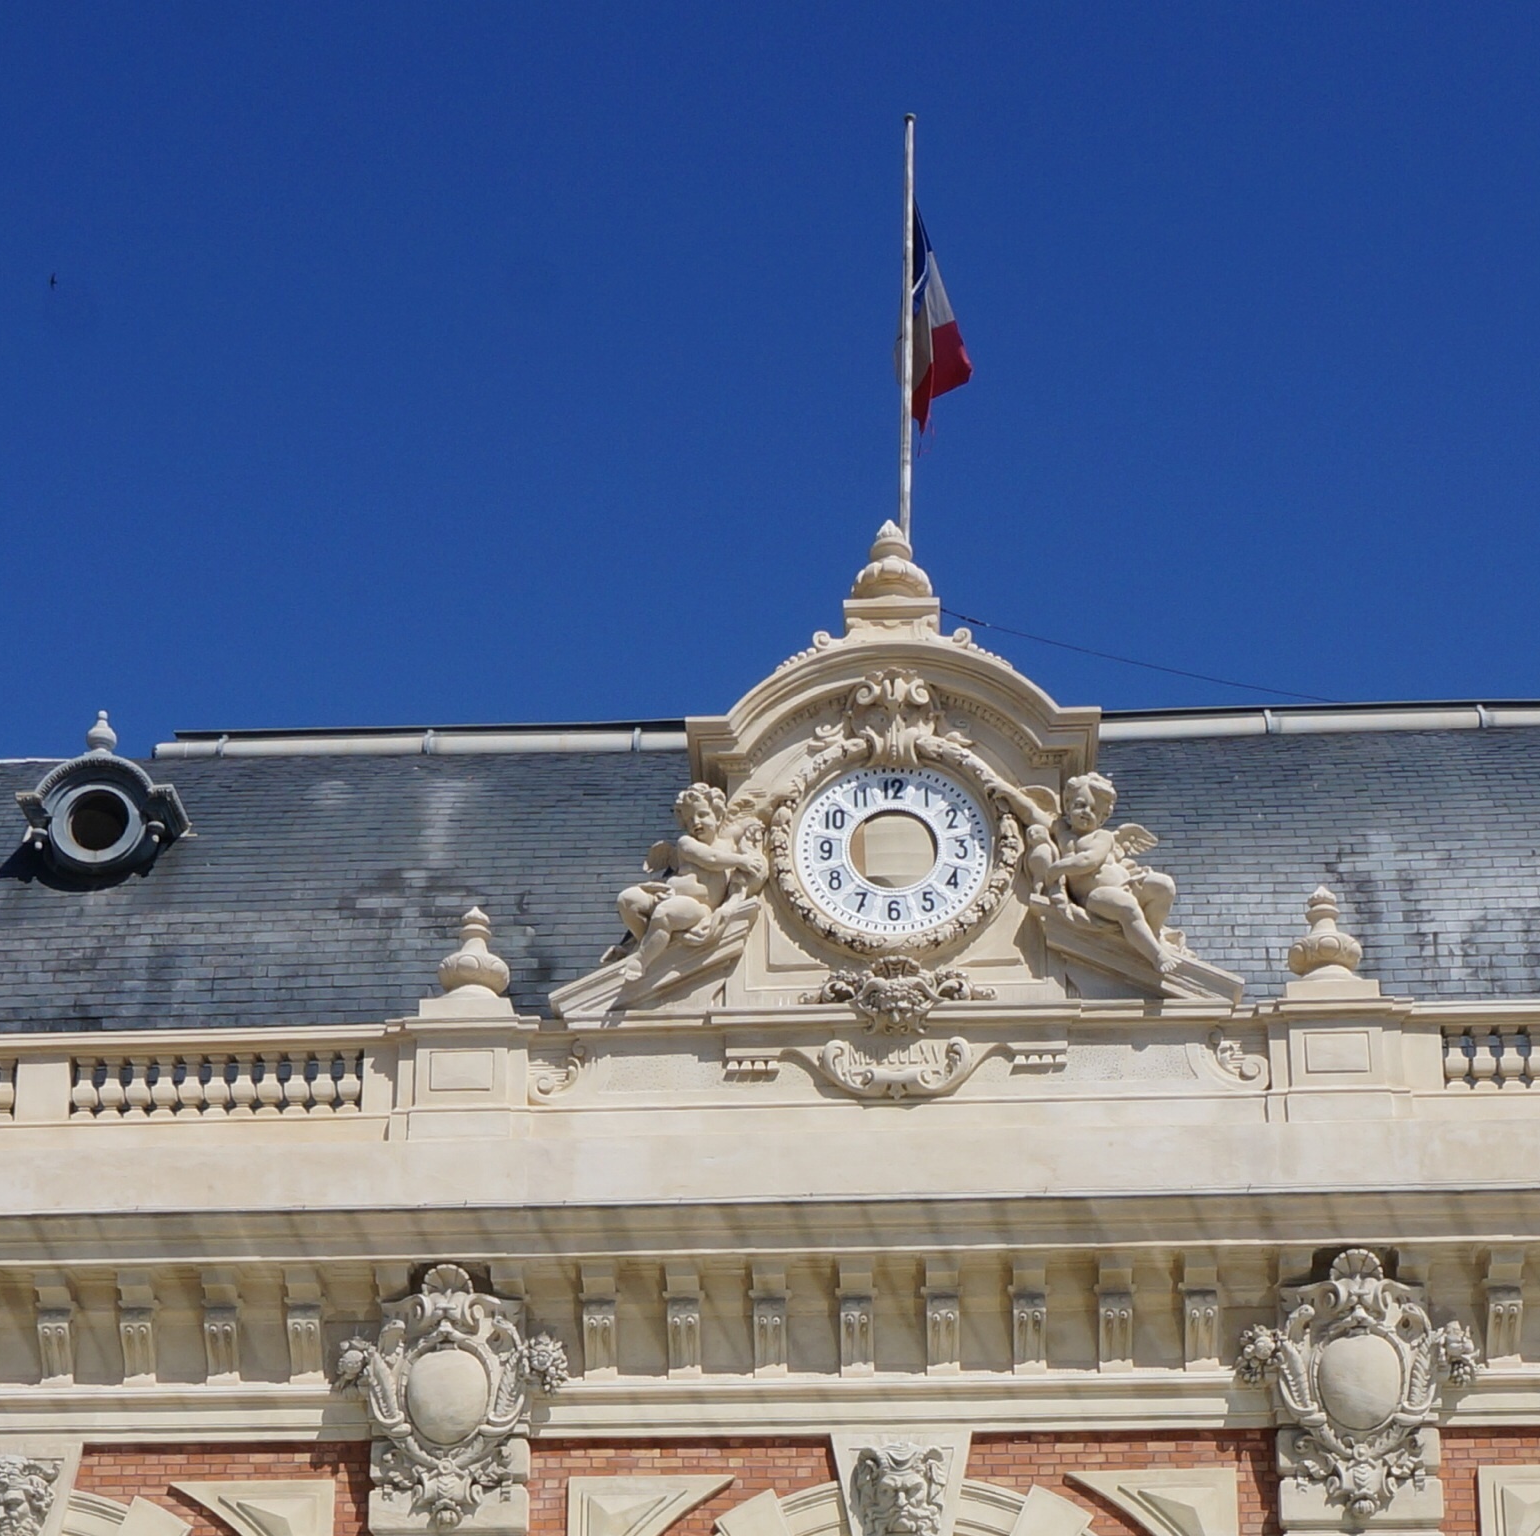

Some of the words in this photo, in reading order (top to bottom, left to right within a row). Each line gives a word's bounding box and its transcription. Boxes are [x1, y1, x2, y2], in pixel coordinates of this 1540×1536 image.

[853, 786, 868, 808] 11
[883, 778, 904, 800] 12
[824, 808, 845, 830] 10
[945, 808, 959, 830] 2
[819, 840, 833, 860] 9
[954, 839, 968, 860] 3
[828, 870, 842, 891] 8
[945, 867, 959, 889] 4
[855, 892, 869, 913] 7
[888, 900, 901, 921] 6
[922, 891, 935, 913] 5
